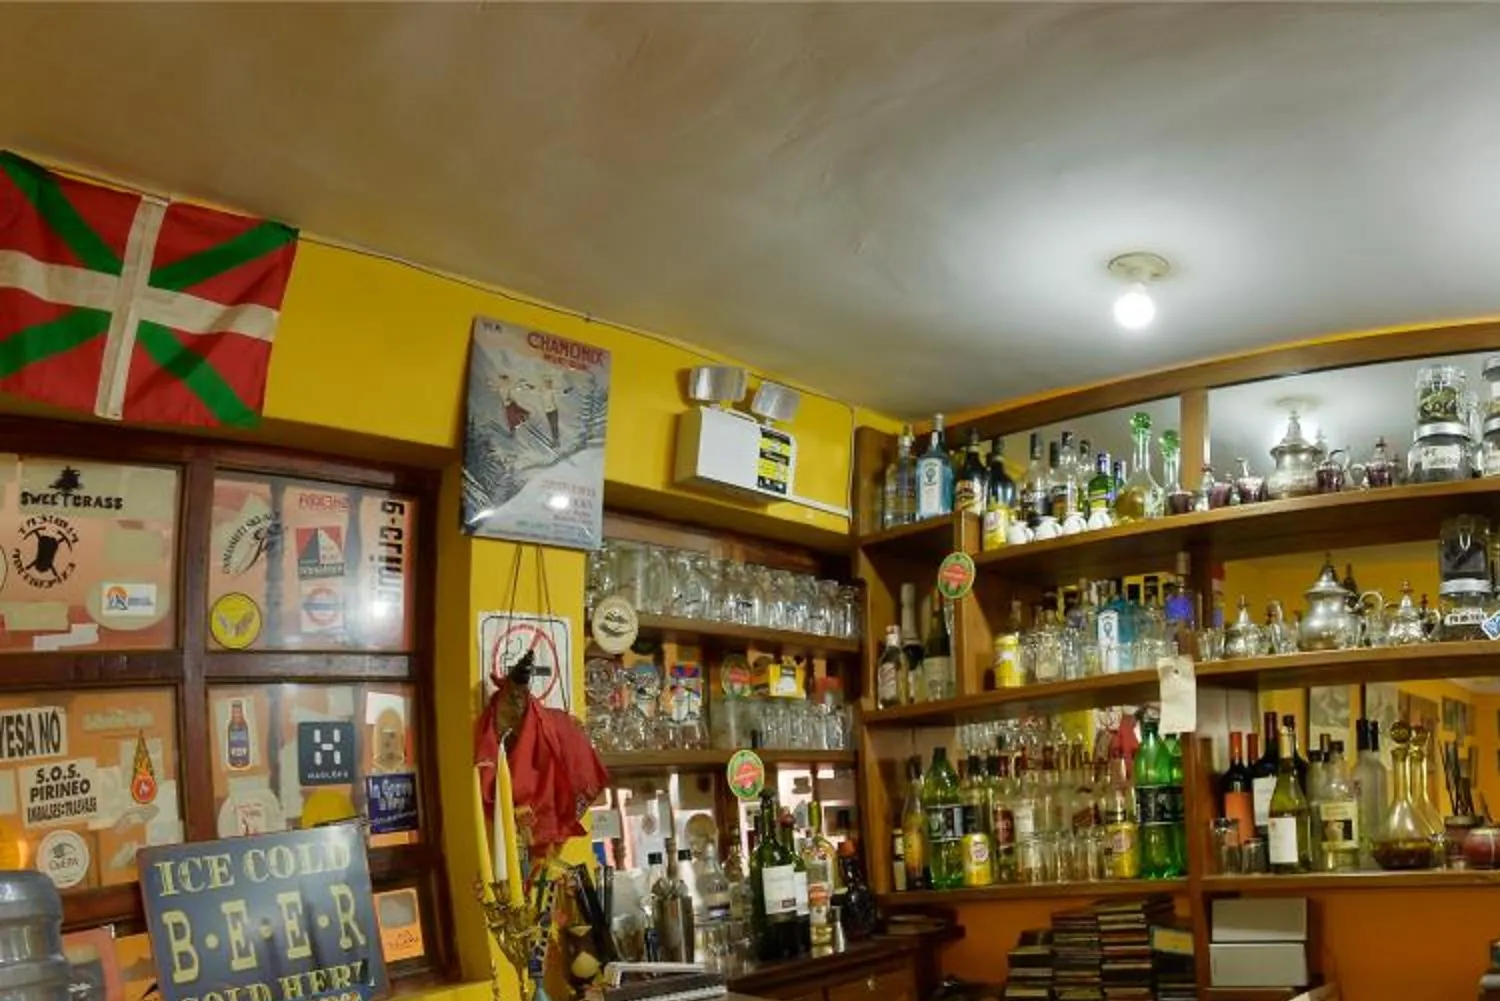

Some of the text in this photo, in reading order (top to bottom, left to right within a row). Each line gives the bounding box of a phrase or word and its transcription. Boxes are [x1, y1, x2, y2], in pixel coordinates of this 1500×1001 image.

[36, 763, 81, 784] S.O.S.
[30, 779, 92, 803] PIRINEO
[155, 842, 351, 897] ICE COLD
